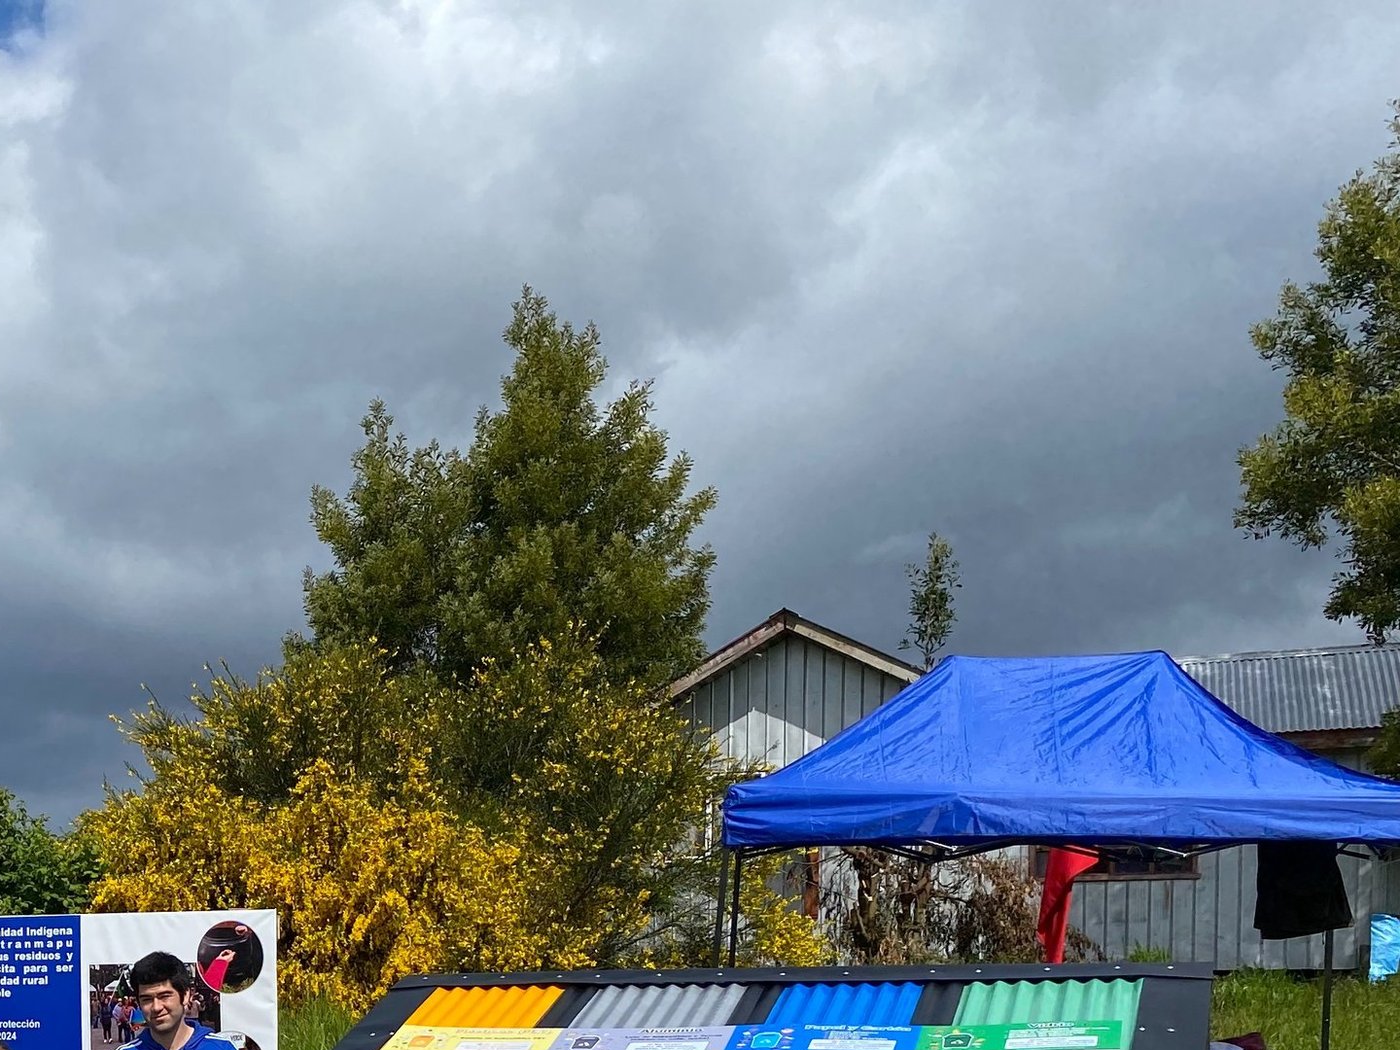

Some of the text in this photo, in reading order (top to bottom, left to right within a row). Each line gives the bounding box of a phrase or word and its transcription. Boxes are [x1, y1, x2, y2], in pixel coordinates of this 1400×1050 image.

[26, 926, 73, 938] Indígena
[14, 951, 61, 961] residuos
[66, 952, 74, 962] y
[23, 965, 48, 975] para
[55, 965, 74, 973] ser
[22, 976, 49, 985] rural
